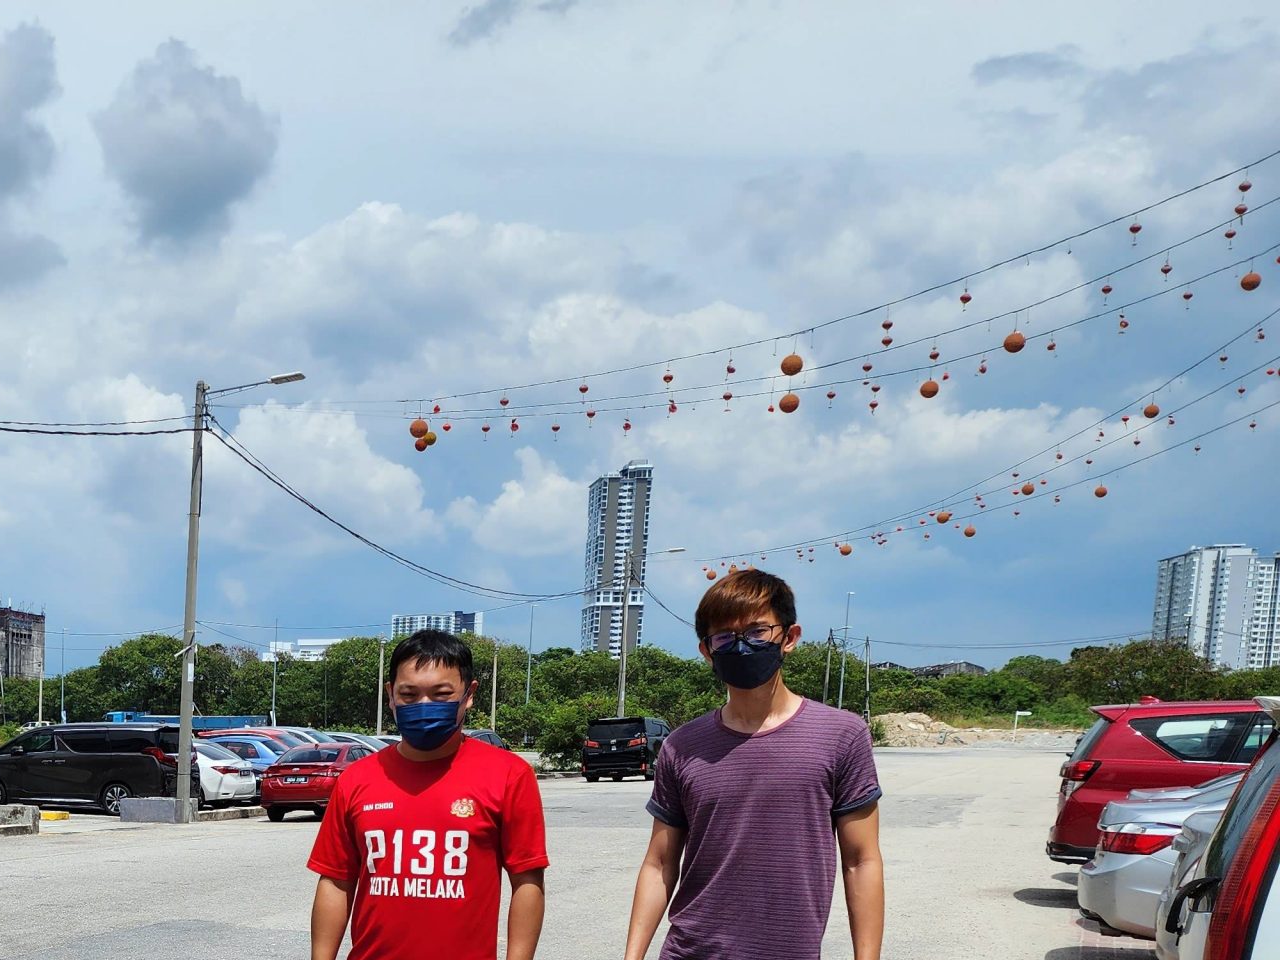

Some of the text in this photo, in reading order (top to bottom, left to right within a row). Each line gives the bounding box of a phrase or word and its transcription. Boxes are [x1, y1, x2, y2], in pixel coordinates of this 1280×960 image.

[364, 829, 470, 876] P138
[369, 876, 465, 899] KOTA MELAKA
